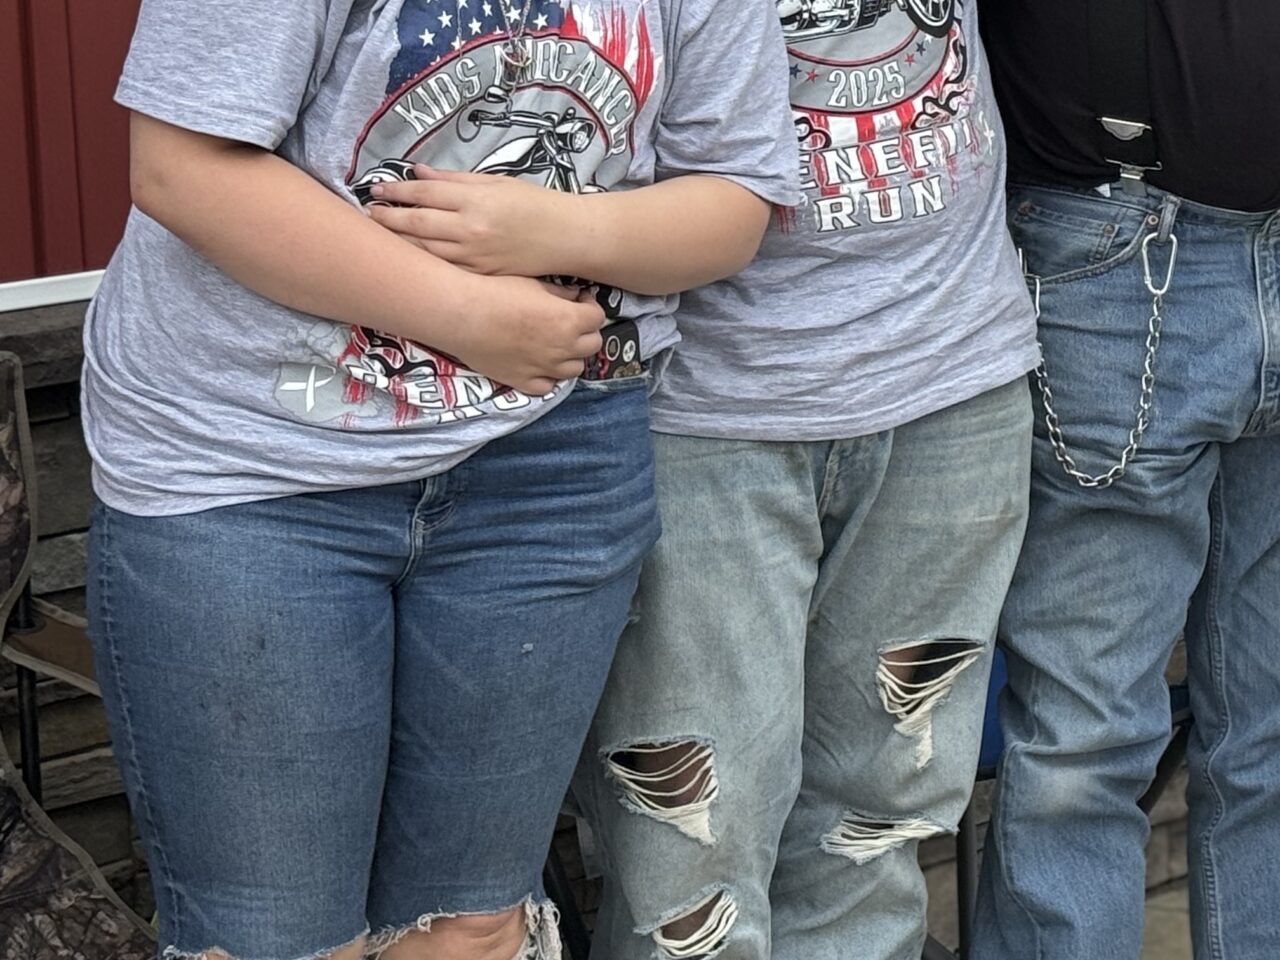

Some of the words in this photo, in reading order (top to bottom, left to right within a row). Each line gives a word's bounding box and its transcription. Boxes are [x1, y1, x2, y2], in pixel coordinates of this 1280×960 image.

[393, 57, 482, 136] KIDS
[826, 60, 905, 107] 2025
[813, 175, 946, 233] RUN
